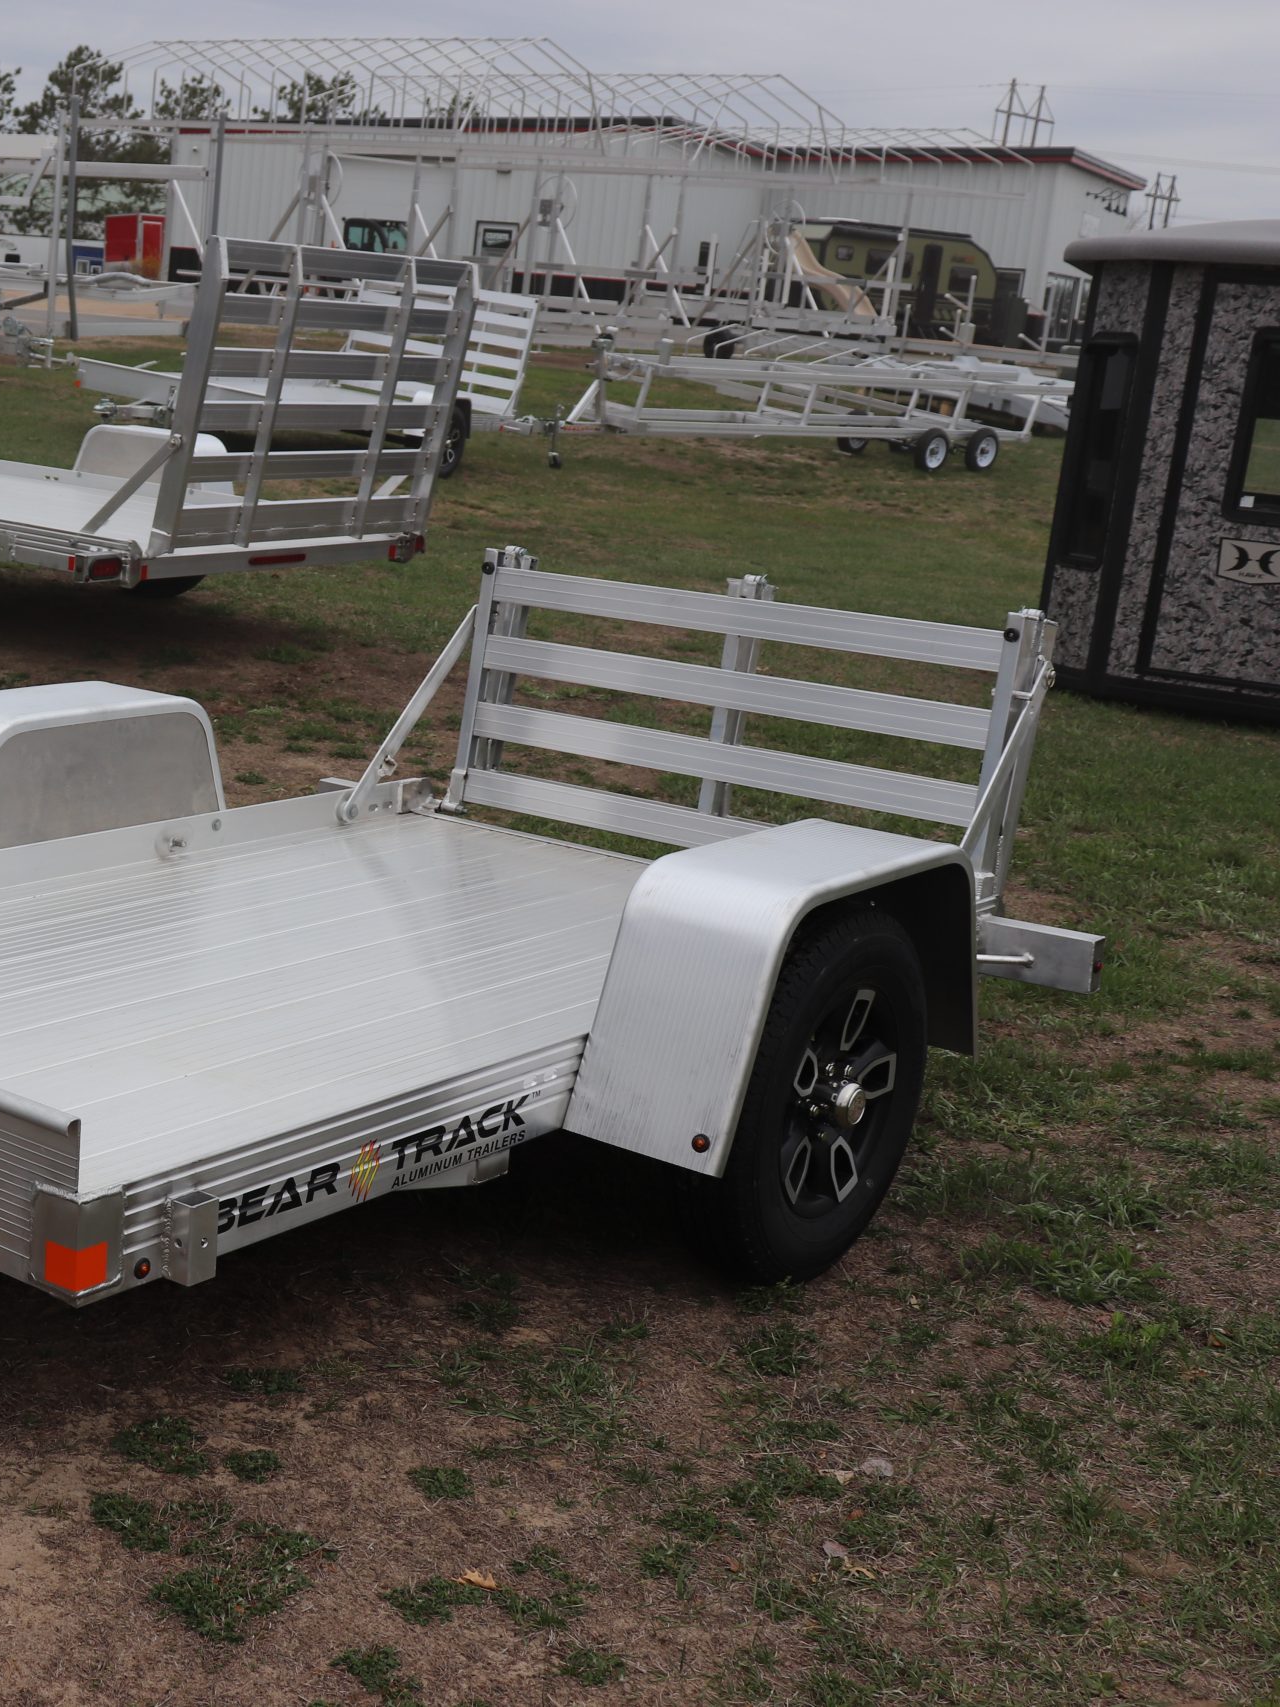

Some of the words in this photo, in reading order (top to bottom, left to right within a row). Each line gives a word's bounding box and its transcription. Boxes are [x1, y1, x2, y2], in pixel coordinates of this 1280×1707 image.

[391, 1094, 530, 1171] TRACK
[391, 1156, 463, 1190] ALUMINUM
[467, 1130, 526, 1162] TRAILERS
